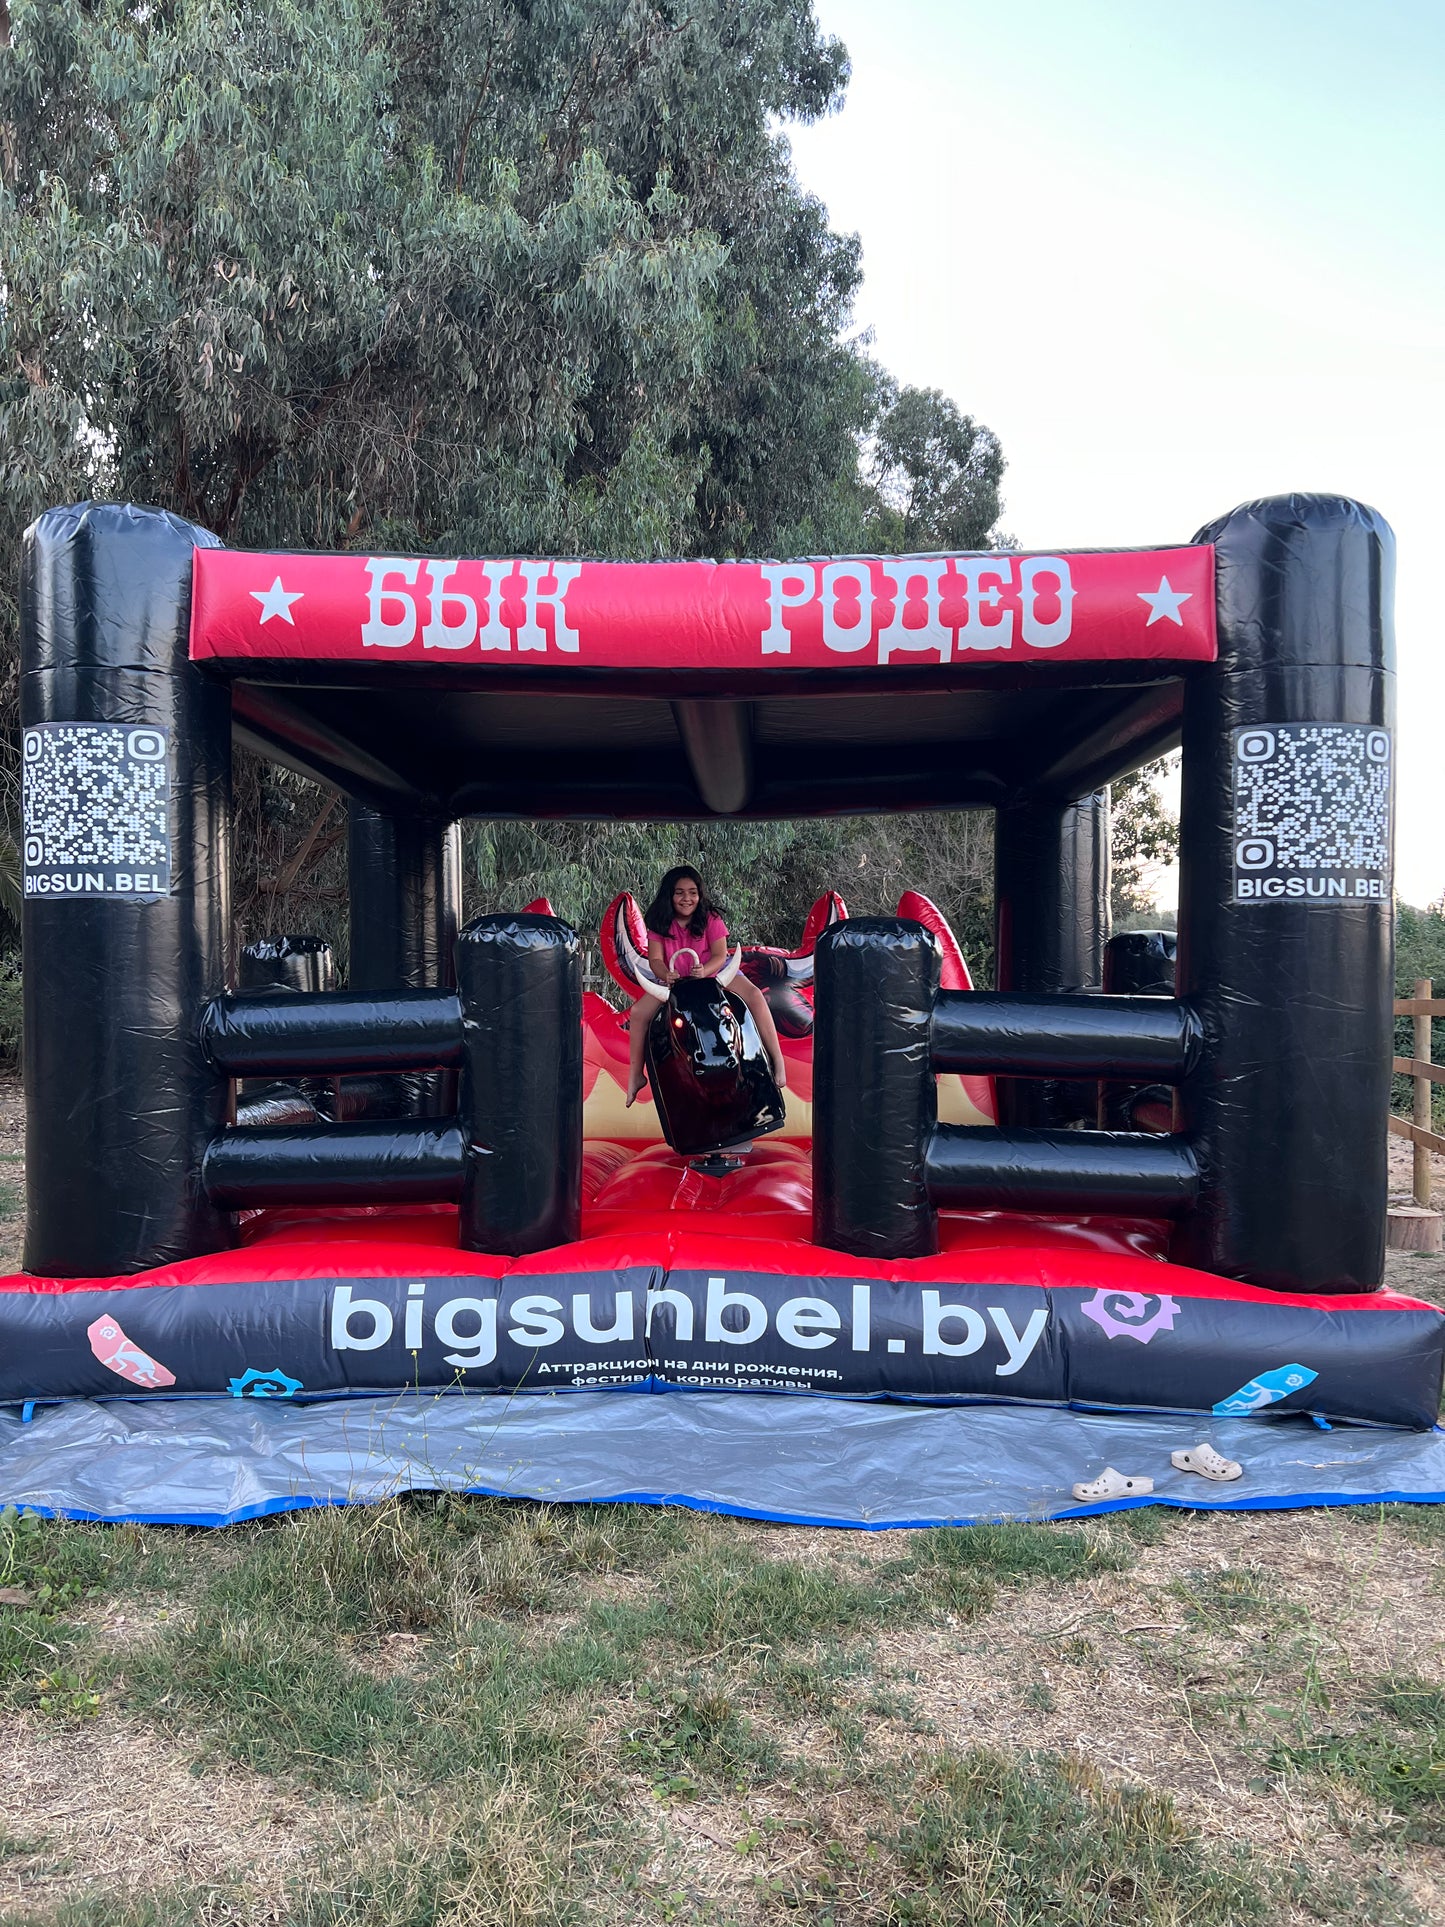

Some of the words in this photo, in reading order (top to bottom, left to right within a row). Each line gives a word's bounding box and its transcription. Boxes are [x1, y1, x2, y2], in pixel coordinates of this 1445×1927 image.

[361, 557, 582, 653] БЫК
[760, 556, 1079, 665] РОДЕО
[25, 872, 167, 893] BIGSUN.BEL
[1237, 876, 1388, 898] BIGSUN.BEL
[331, 1277, 1049, 1377] bigsunbel.by
[537, 1358, 660, 1375] Аттракцион
[664, 1360, 689, 1370] на
[691, 1360, 730, 1371] дни
[734, 1362, 843, 1381] рождения,
[571, 1373, 671, 1387] фестиви,
[676, 1375, 812, 1388] корпоративы
